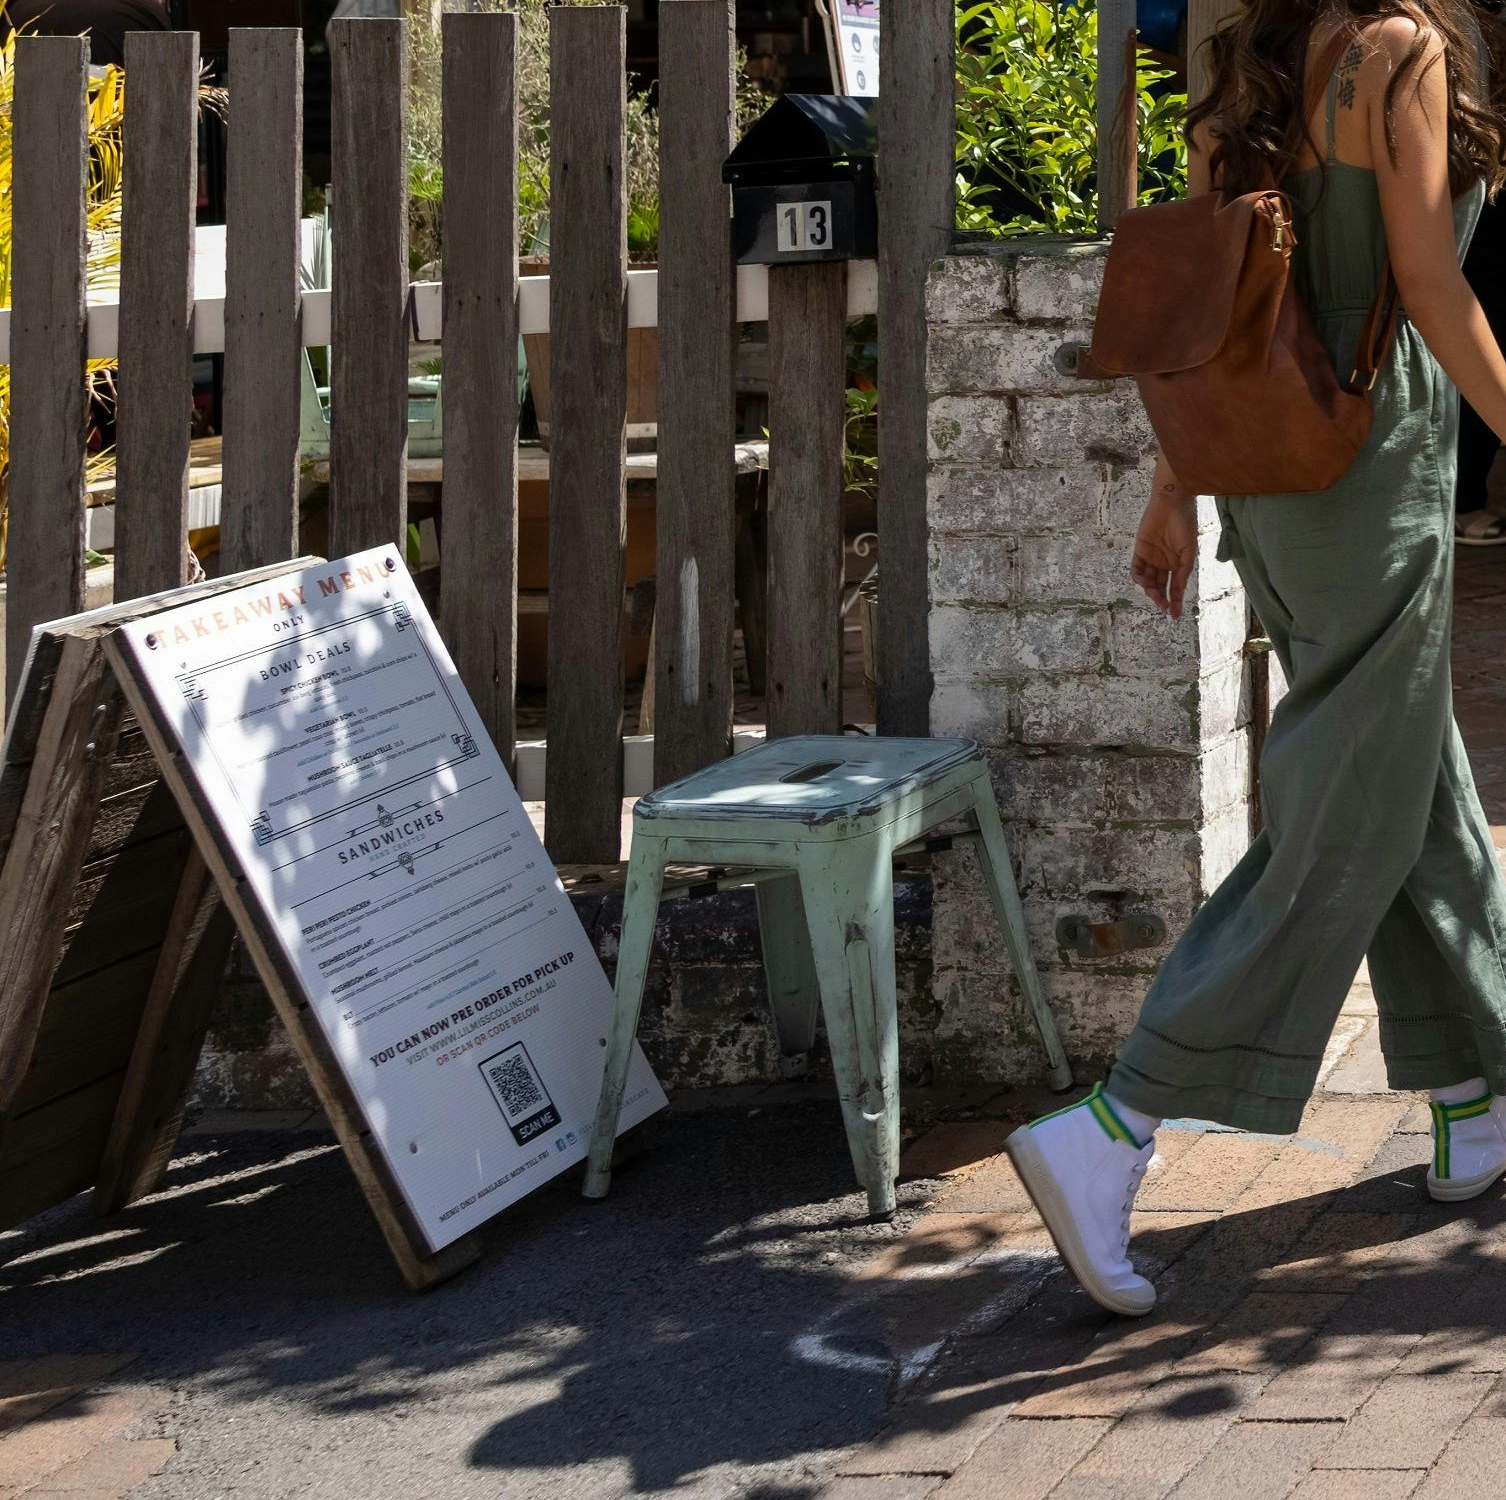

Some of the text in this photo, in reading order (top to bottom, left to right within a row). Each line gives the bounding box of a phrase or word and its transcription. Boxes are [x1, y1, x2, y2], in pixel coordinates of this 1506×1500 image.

[783, 205, 828, 247] 13
[153, 564, 391, 650] TAKEAWAY MENU
[272, 614, 306, 633] ONLY
[259, 641, 351, 681] BOWL DEALS
[307, 764, 341, 781] MUSHROOM
[338, 810, 444, 863] SANDWICHES
[368, 832, 426, 862] HAND CRAFTED
[328, 910, 347, 923] PESTO
[347, 899, 371, 914] CHICKEN
[318, 938, 375, 969] CRUMBED EGGPLANT
[330, 966, 380, 994] MUSHROOM MELT
[342, 1010, 355, 1021] BLT
[369, 1045, 396, 1067] YOU
[394, 1032, 421, 1054] CAN
[420, 1016, 452, 1040] NOW
[450, 1004, 475, 1025] PRE
[473, 984, 513, 1012] ORDER
[512, 973, 535, 992] FOR
[534, 959, 561, 981] PICK
[559, 951, 576, 967] UP
[406, 1047, 429, 1064] VISIT
[429, 979, 557, 1052] WWW.LILMISSCOLLINS.COM.AU
[435, 1004, 541, 1066] OR SCAN QR CODE BELOW
[518, 1111, 554, 1139] SCAN ME
[439, 1149, 551, 1221] MENU ONLY AVAILABLE MON TILL FRI
